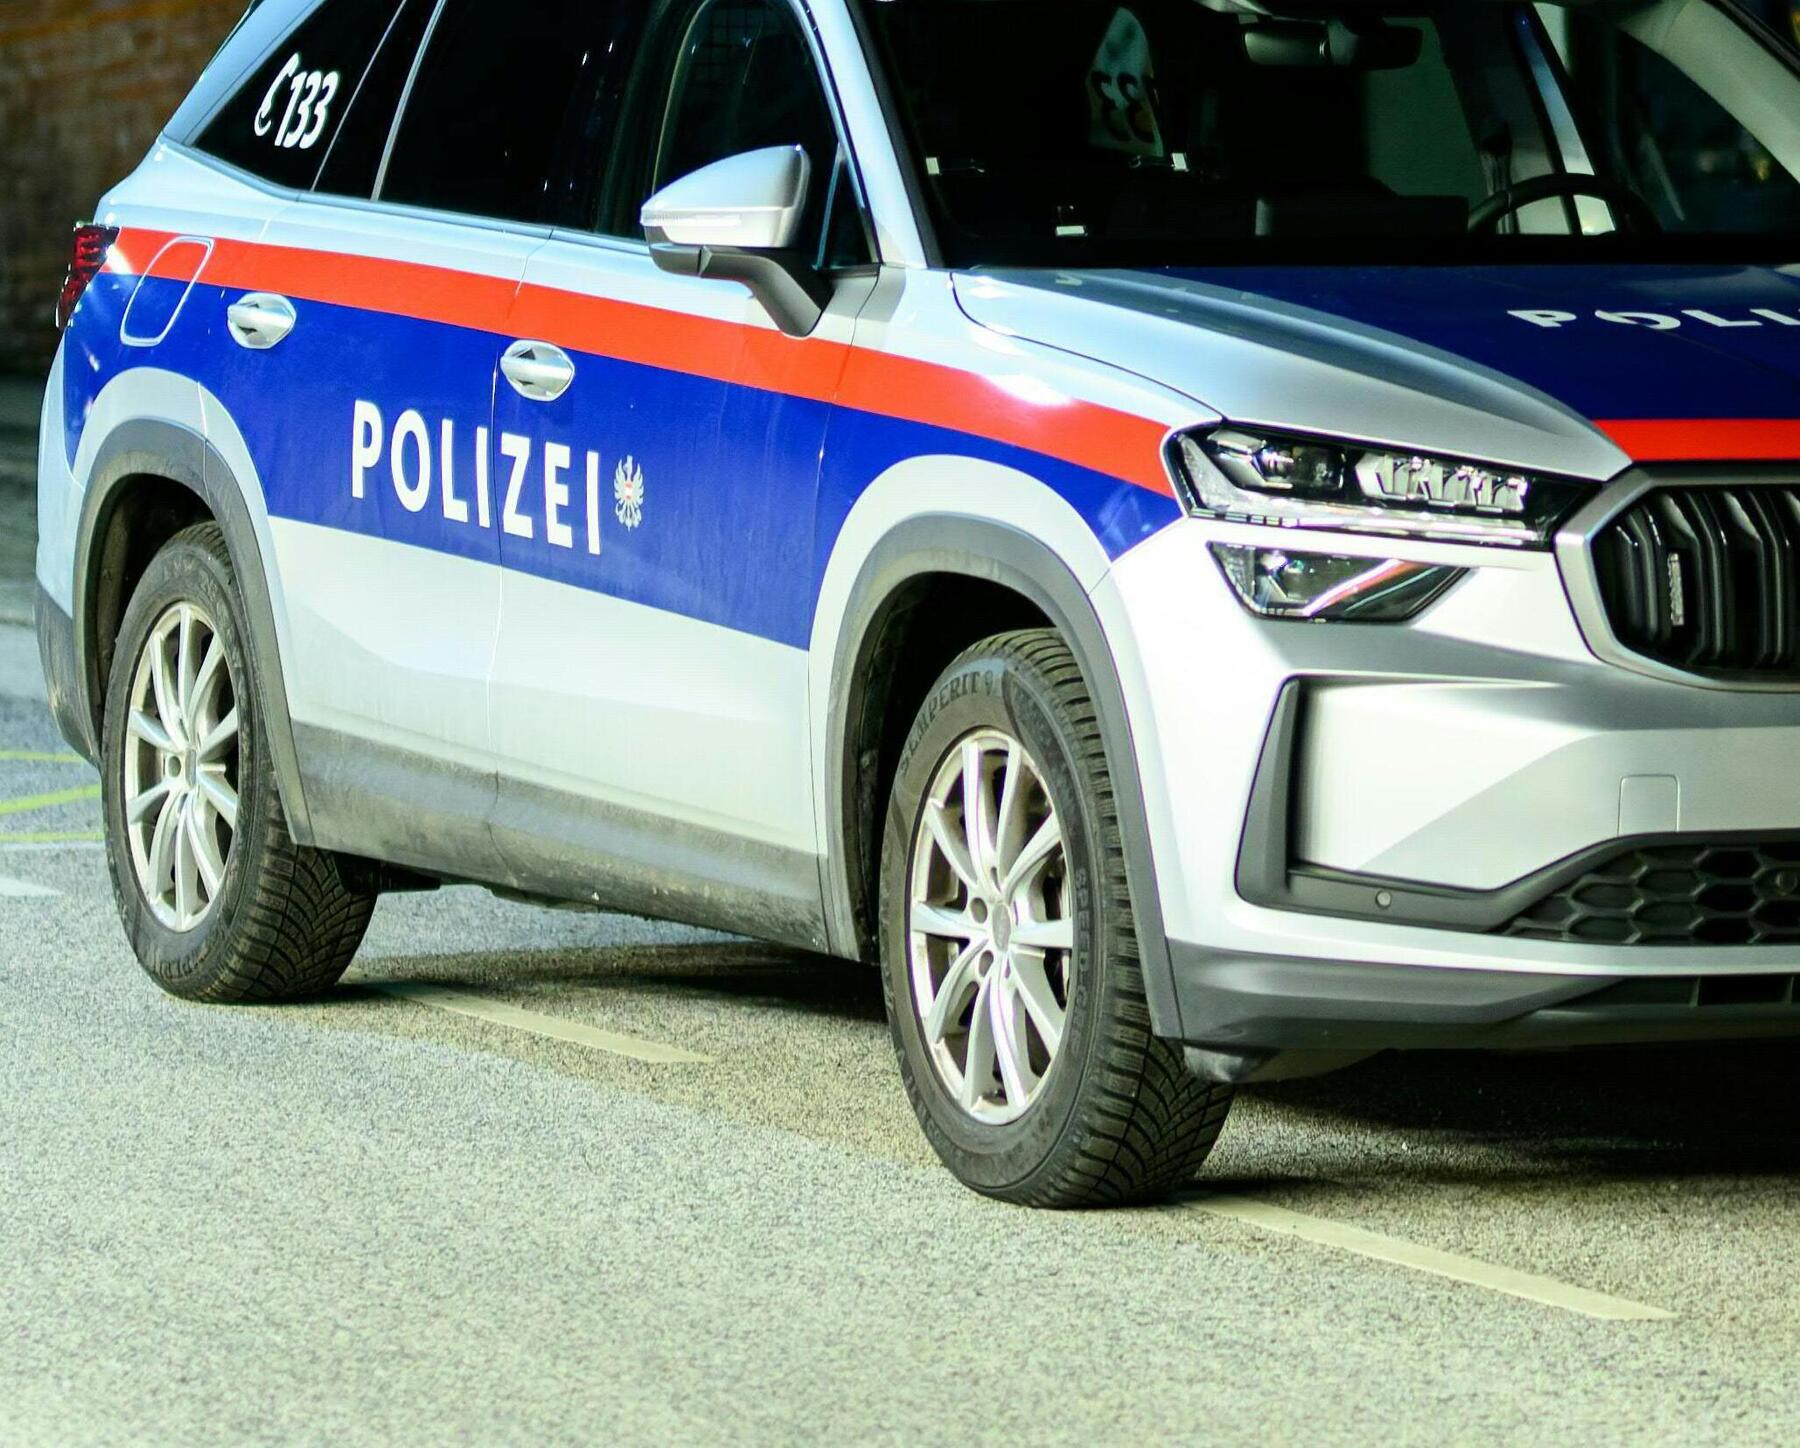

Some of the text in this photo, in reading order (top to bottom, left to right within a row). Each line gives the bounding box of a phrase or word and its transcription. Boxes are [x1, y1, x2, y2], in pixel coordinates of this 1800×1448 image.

[274, 70, 339, 149] 133
[1506, 309, 1800, 330] POLI
[351, 399, 600, 555] POLIZEI
